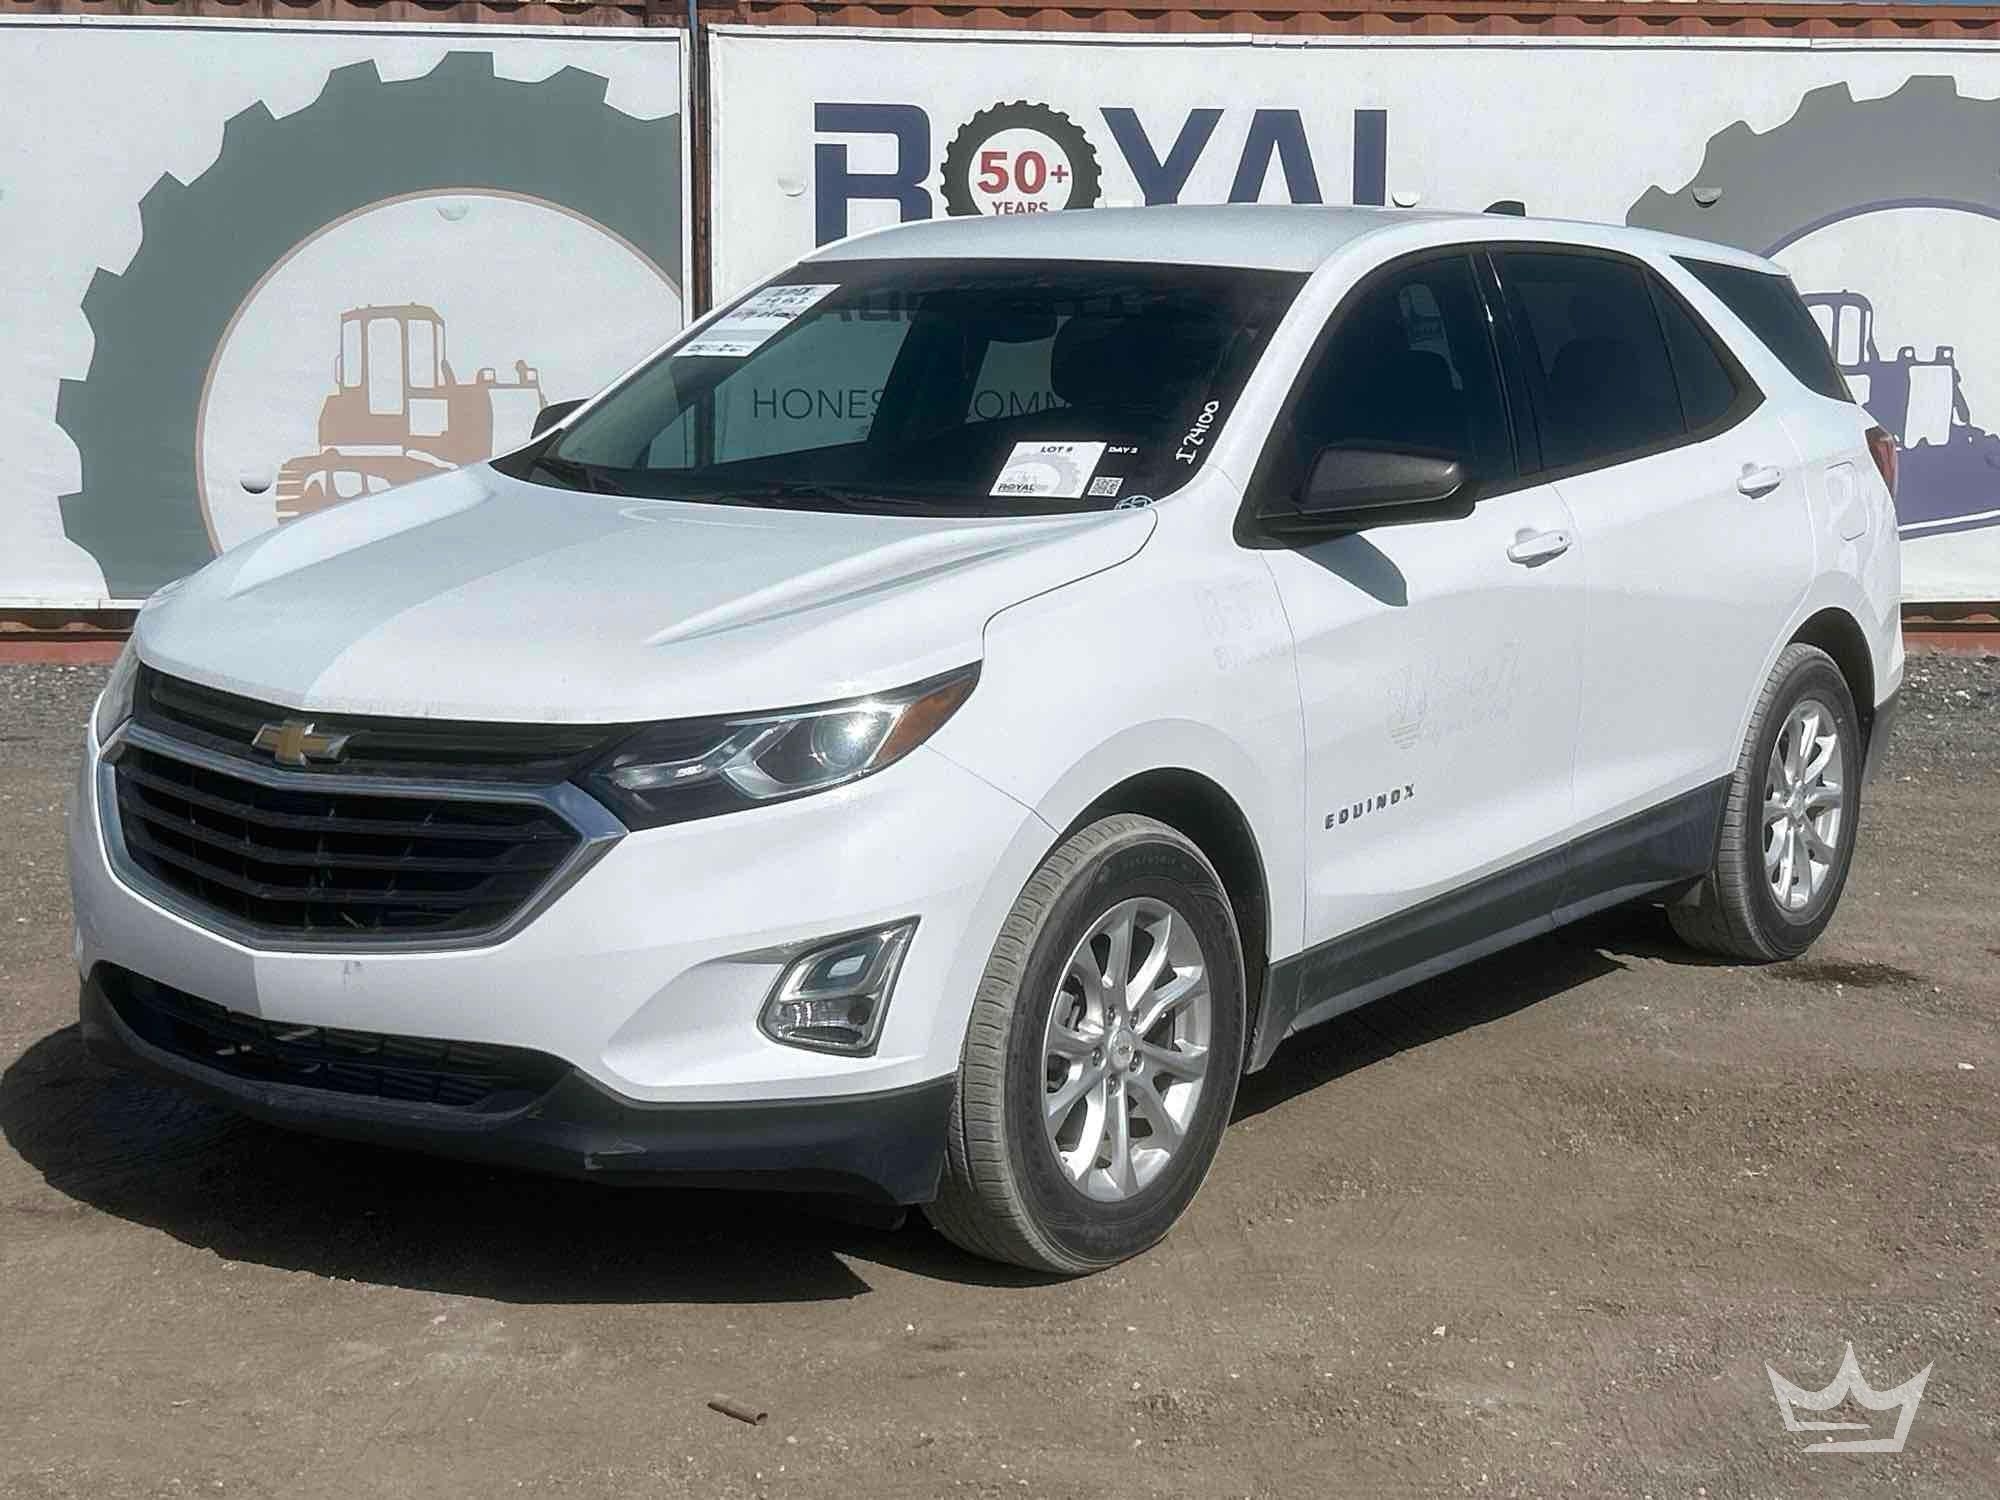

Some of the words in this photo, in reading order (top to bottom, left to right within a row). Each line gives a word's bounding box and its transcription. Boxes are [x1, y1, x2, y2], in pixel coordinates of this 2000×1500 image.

[977, 150, 1070, 195] 50+
[991, 201, 1050, 215] YEARS
[1040, 446, 1064, 454] LOT
[1108, 446, 1130, 455] DAY
[1324, 783, 1415, 830] EQUINOX
